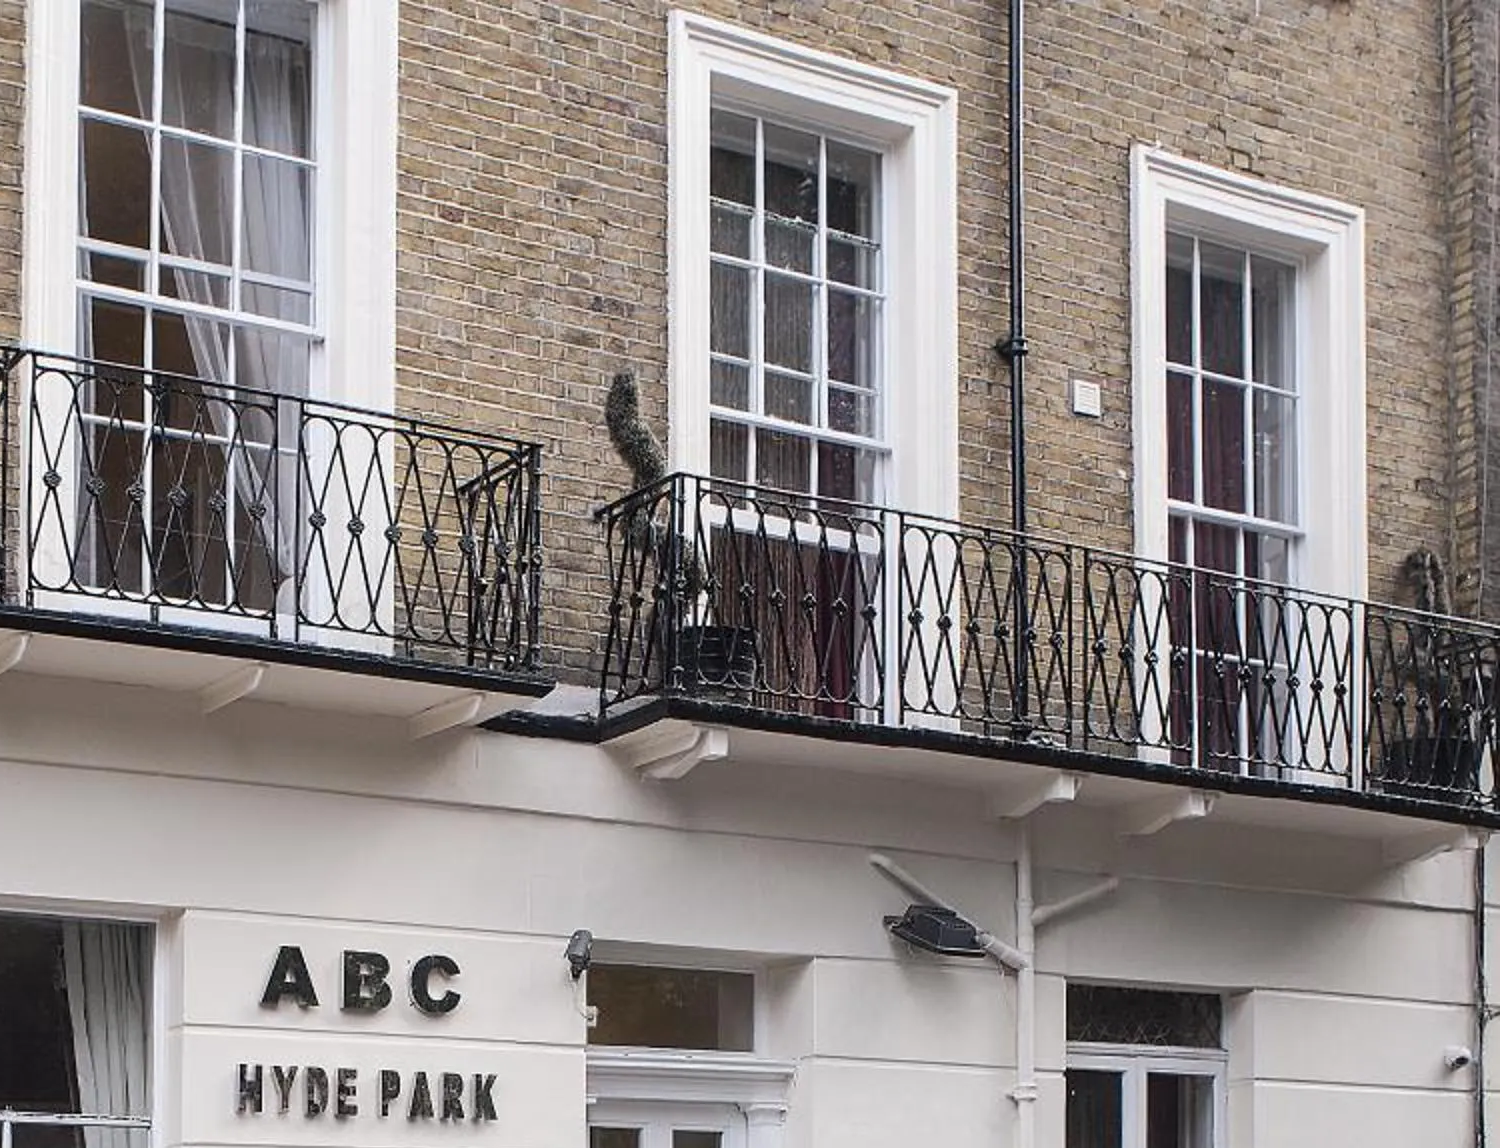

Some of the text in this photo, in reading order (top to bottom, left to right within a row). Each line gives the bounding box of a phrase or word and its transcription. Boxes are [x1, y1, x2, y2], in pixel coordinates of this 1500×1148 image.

[258, 945, 462, 1015] ABC
[235, 1063, 499, 1121] HYDE PARK
